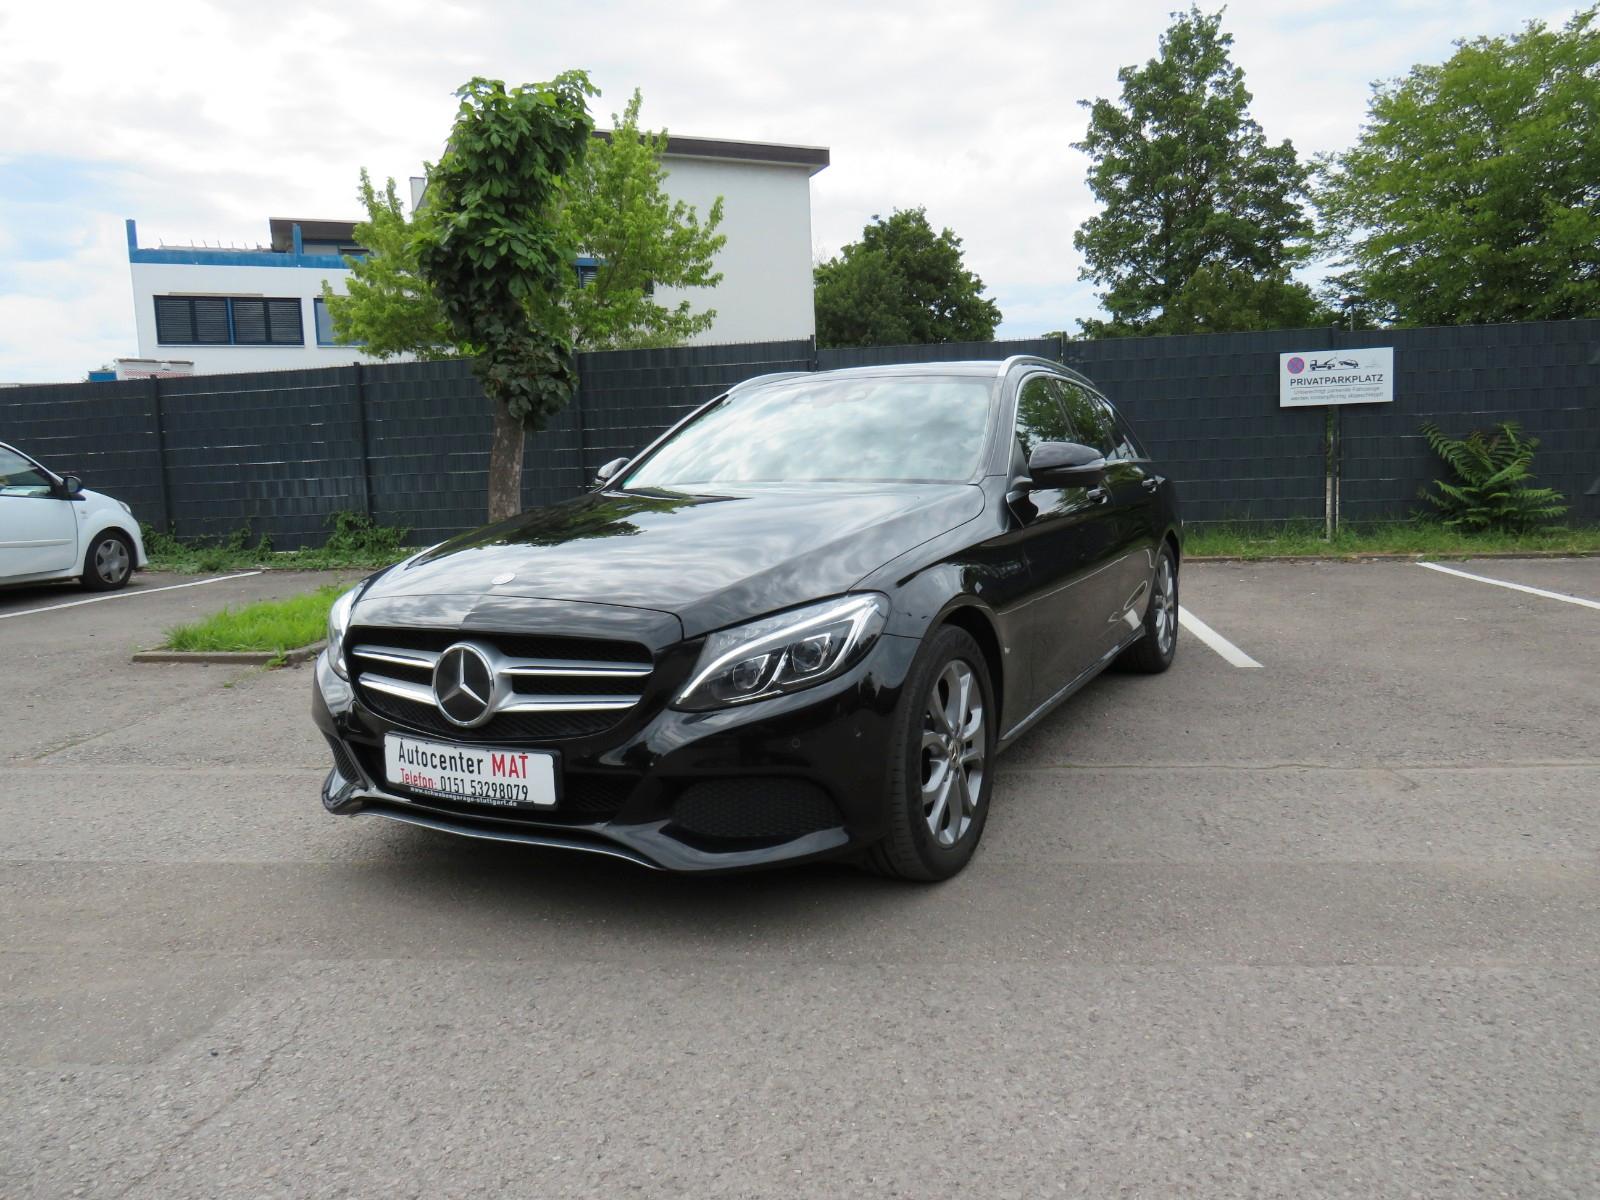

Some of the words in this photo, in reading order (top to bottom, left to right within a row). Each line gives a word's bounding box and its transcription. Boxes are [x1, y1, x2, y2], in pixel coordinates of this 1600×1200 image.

[1290, 374, 1384, 386] PRIVATPARKPLATZ
[398, 740, 484, 775] Autocenter
[491, 753, 529, 779] MAT
[440, 775, 466, 794] 0151
[470, 779, 529, 801] 53298079
